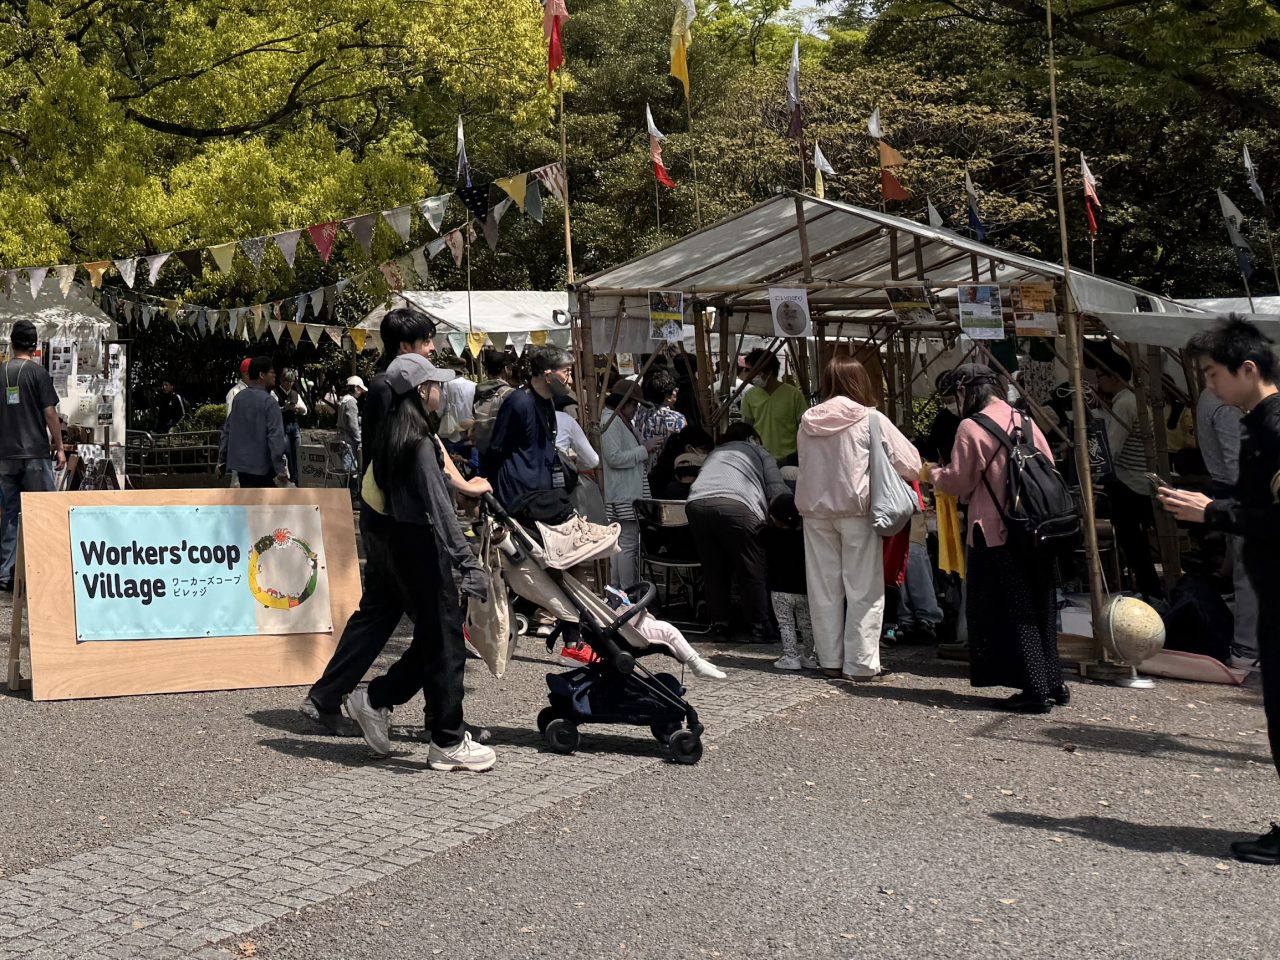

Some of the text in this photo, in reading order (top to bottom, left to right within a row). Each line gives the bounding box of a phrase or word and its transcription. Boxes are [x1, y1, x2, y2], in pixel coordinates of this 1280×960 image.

[80, 540, 241, 570] Workers'coop
[82, 572, 242, 605] Village ワーカーズコープ
[173, 587, 207, 597] ビレッジ
